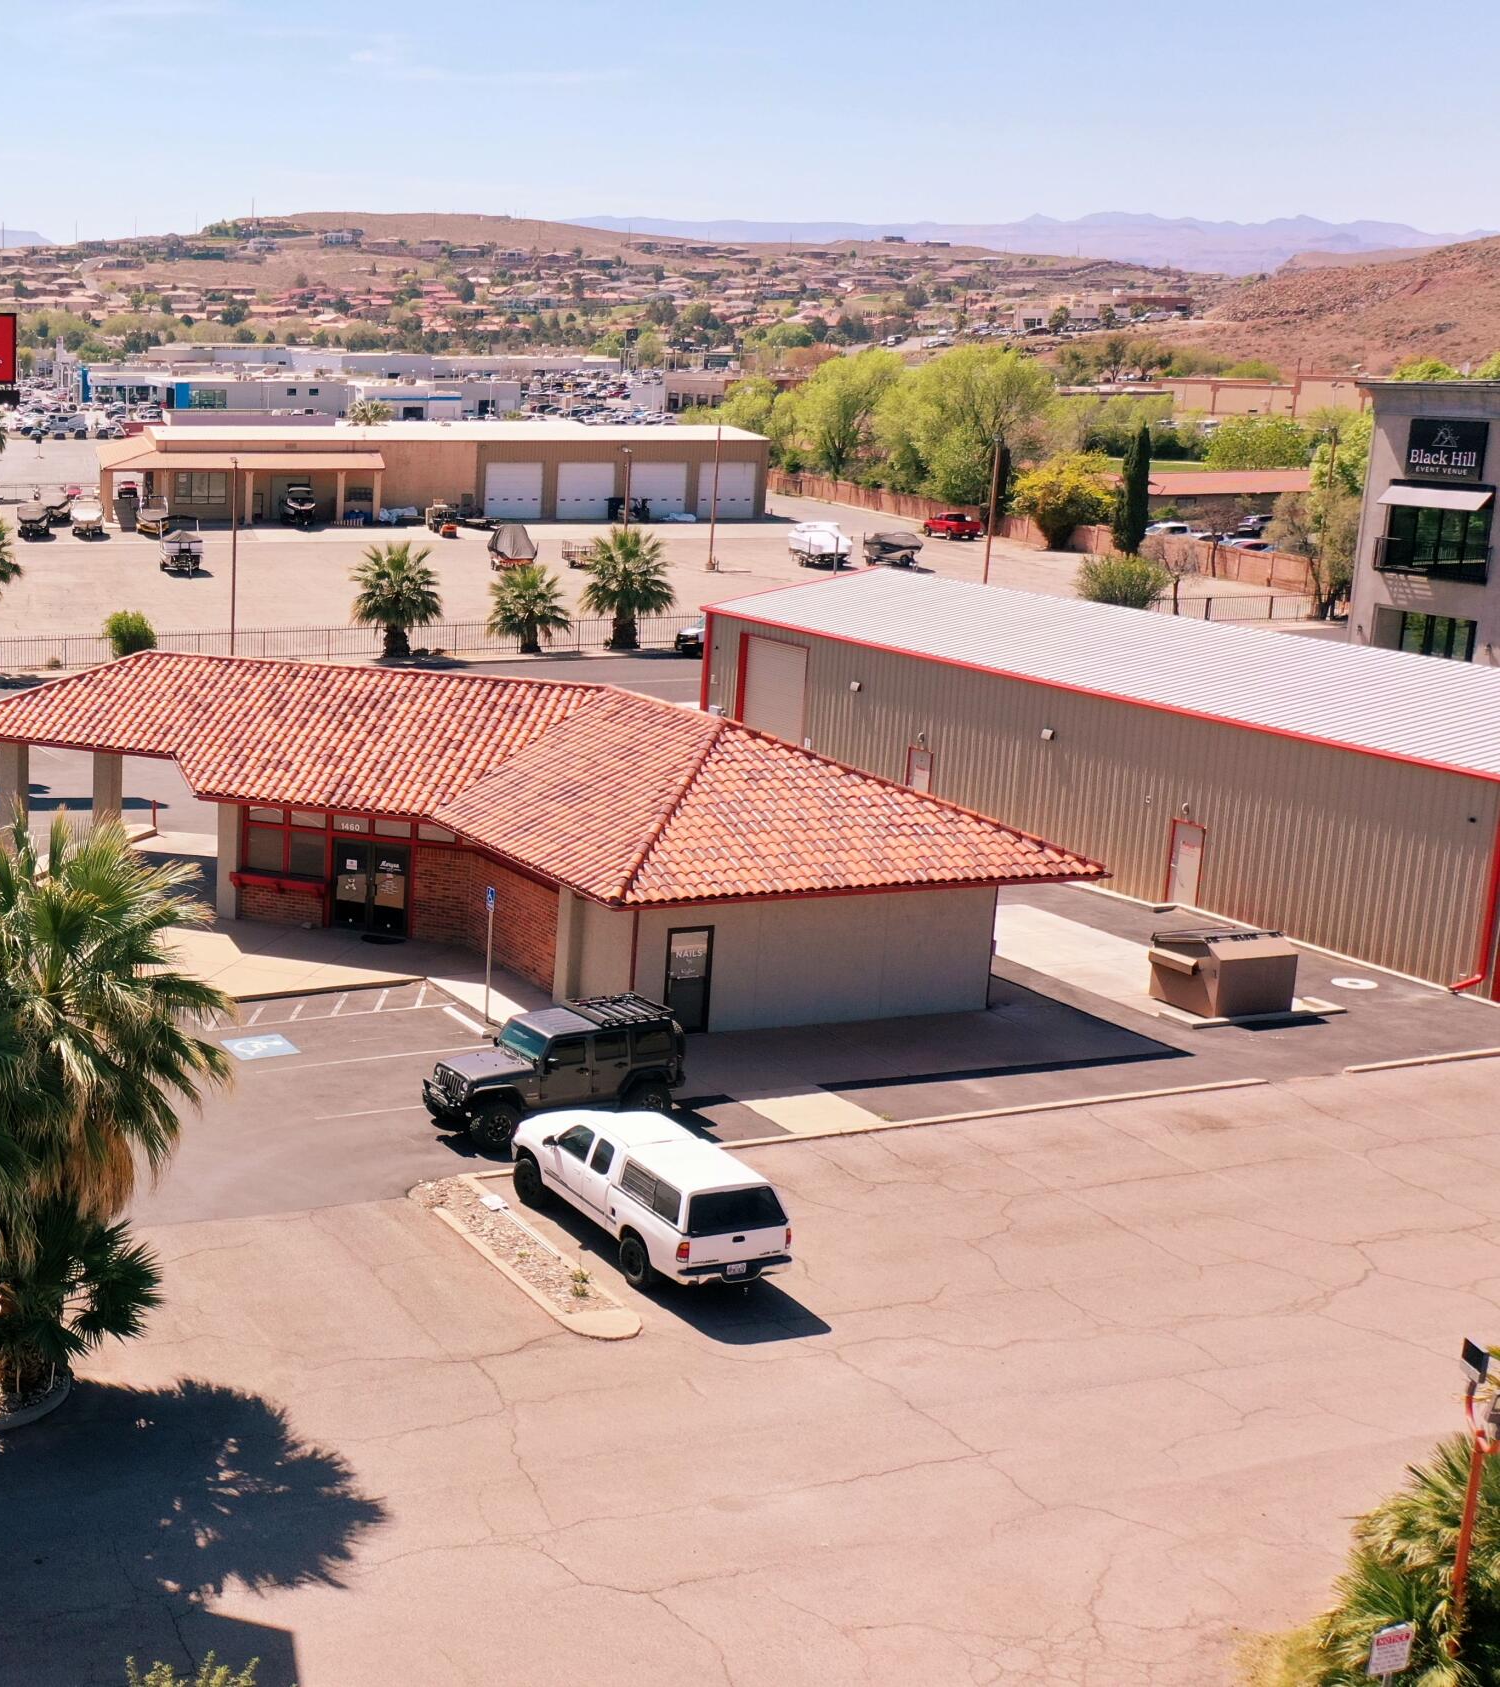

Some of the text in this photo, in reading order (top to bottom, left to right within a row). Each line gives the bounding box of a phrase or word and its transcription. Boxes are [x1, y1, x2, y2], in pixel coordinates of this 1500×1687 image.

[1410, 449, 1476, 467] Black Hill
[1442, 467, 1468, 475] VENUE
[340, 823, 360, 832] 1460
[675, 949, 703, 958] NAILS
[1377, 1632, 1409, 1646] NOTICE
